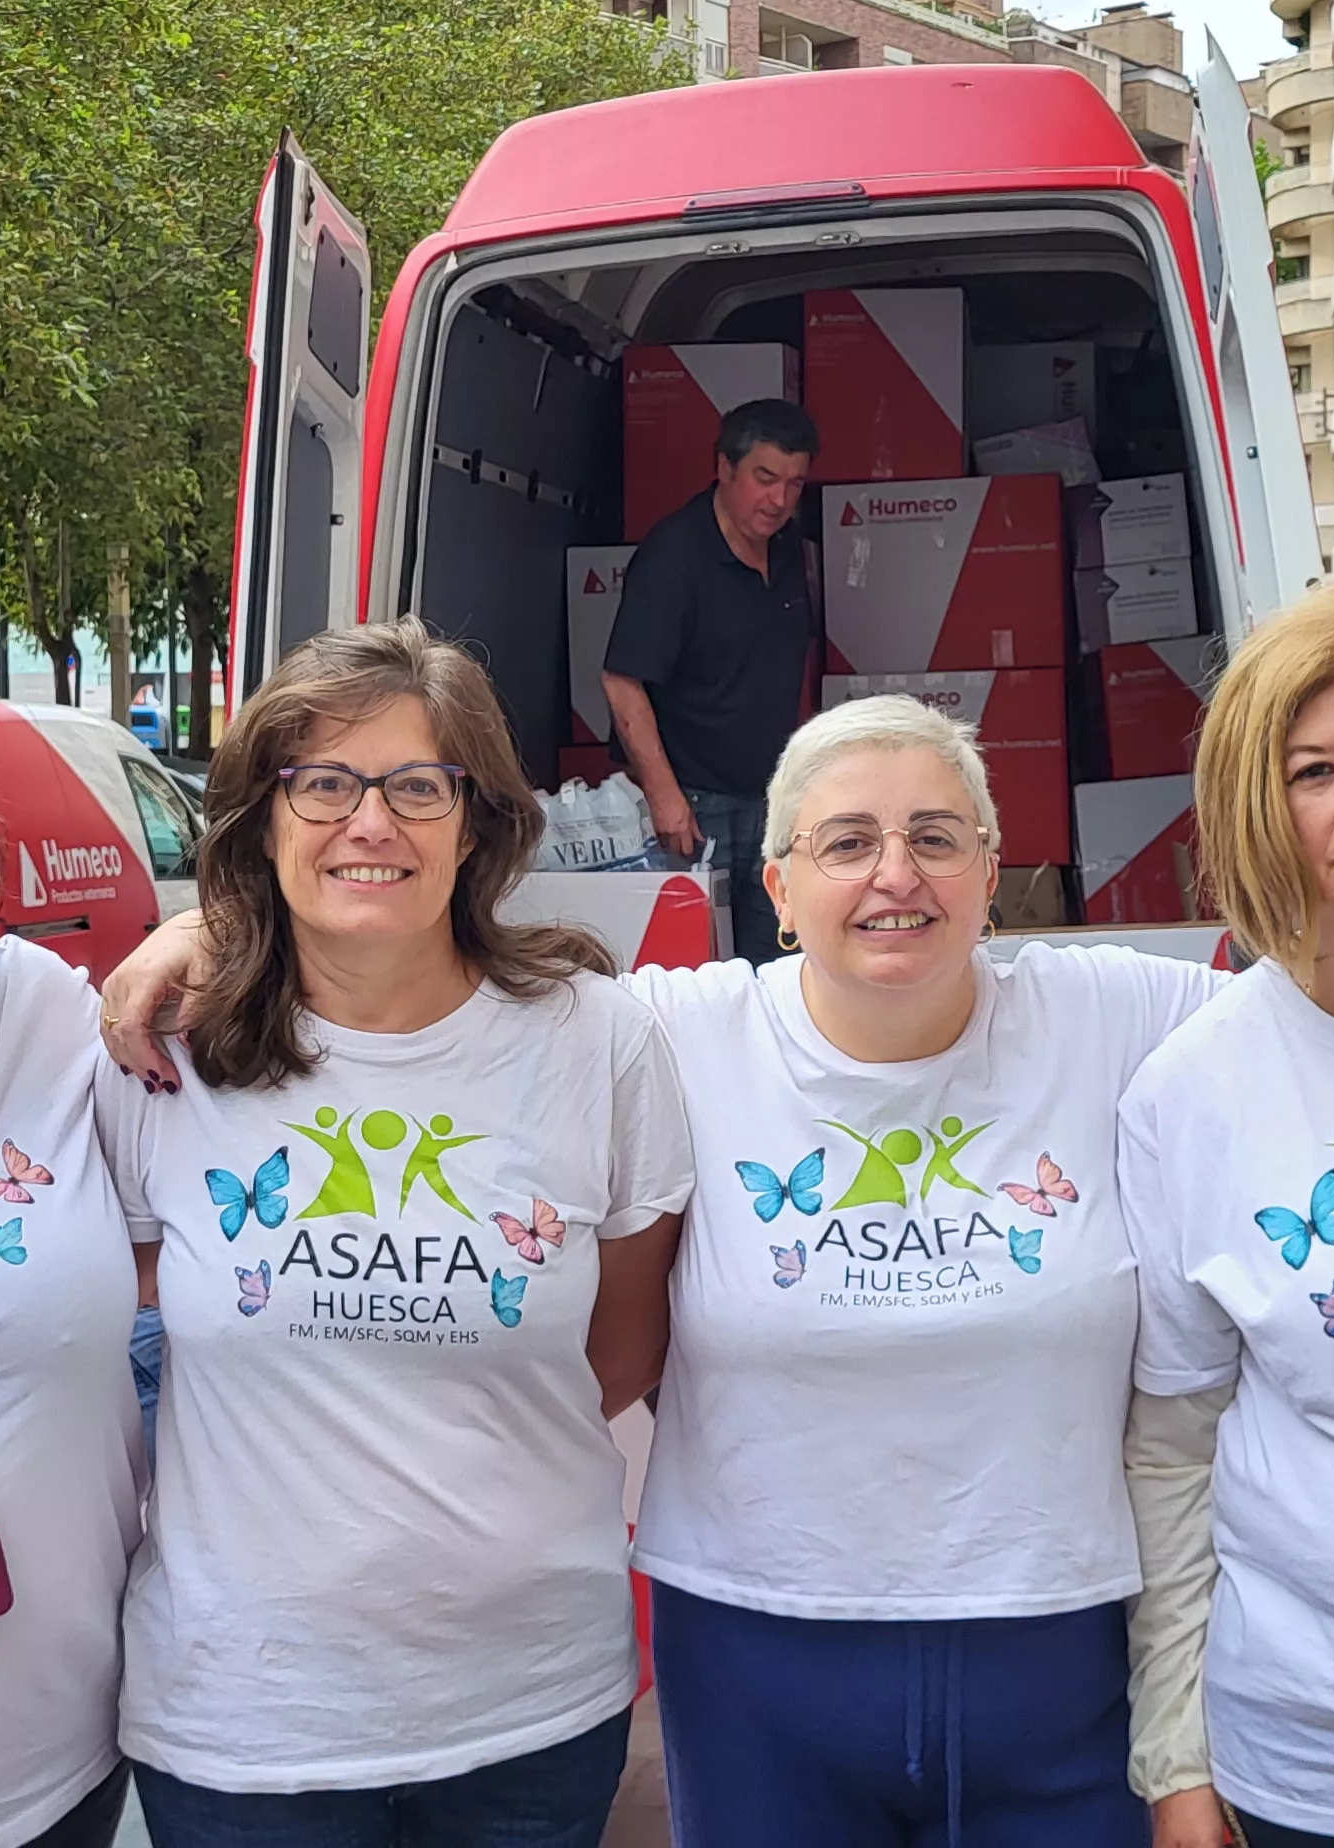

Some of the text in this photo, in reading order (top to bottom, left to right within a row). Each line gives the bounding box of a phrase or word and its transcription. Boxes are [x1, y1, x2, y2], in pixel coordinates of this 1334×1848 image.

[869, 498, 957, 516] Humeco
[41, 838, 122, 882] Humeco
[815, 1212, 1005, 1262] ASAFA
[279, 1229, 488, 1283] ASAFA
[844, 1260, 980, 1292] HUESCA
[313, 1290, 457, 1324] HUESCA
[820, 1293, 848, 1307] FM,
[921, 1293, 956, 1305] SQM
[961, 1291, 969, 1304] y
[975, 1282, 1003, 1298] EHS
[289, 1323, 479, 1345] FM, EM/SFC, SQM y EHS
